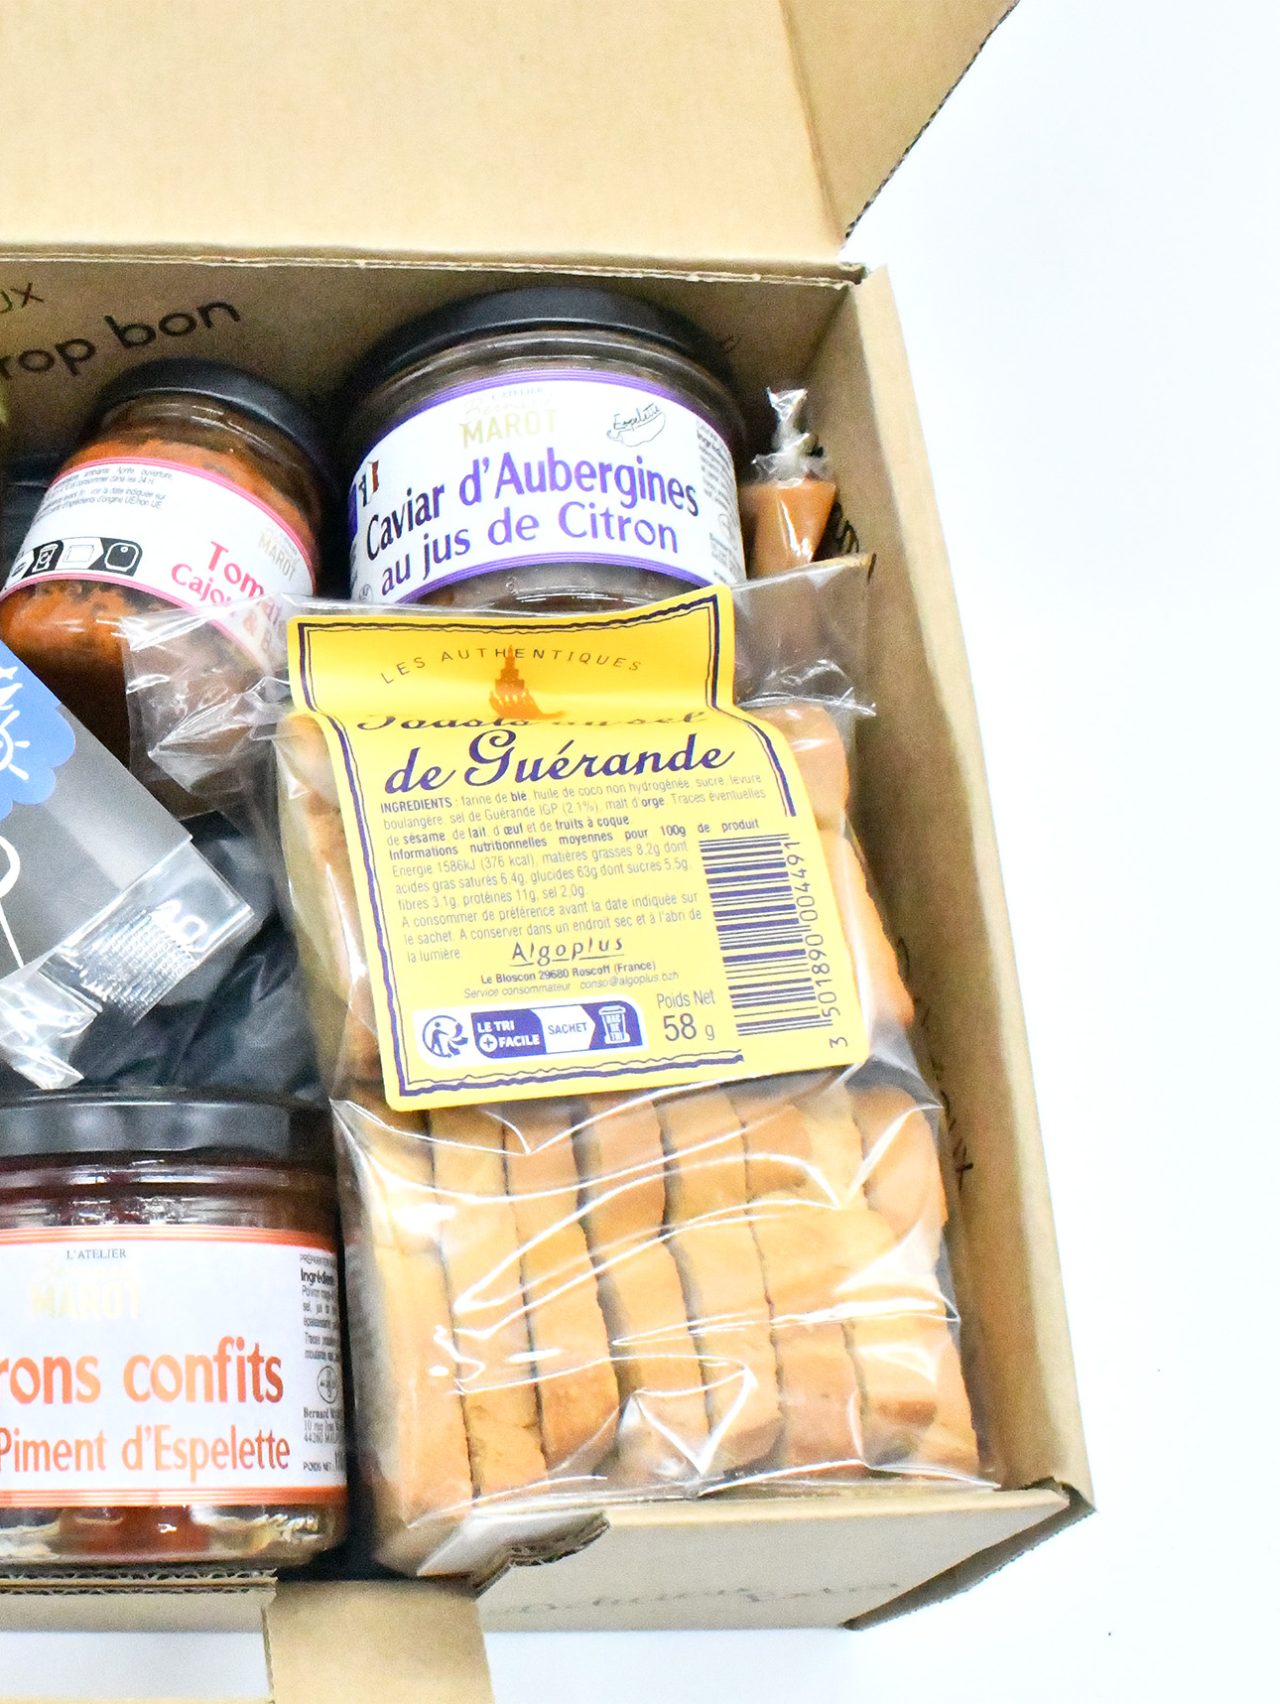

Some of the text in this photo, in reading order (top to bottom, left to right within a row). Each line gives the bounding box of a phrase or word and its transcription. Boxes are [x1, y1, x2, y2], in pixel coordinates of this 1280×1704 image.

[104, 300, 241, 349] bon
[365, 481, 446, 562] Caviar
[458, 446, 701, 517] d'Aubergines
[380, 501, 679, 597] au jus de Citron
[170, 562, 232, 608] Cajo
[380, 647, 643, 685] LES AUTHENTIQUES
[384, 728, 736, 795] de Guérande
[380, 797, 453, 814] INGREDIENTS
[460, 794, 492, 807] farine
[494, 792, 508, 804] de
[533, 788, 559, 800] huile
[562, 786, 575, 798] de
[578, 785, 604, 797] coco
[606, 783, 627, 794] non
[728, 774, 762, 785] levure
[450, 812, 465, 825] sel
[468, 810, 481, 823] de
[484, 805, 537, 822] Guérande
[540, 802, 558, 816] IGP
[606, 798, 628, 810] malt
[669, 792, 707, 805] Traces
[387, 835, 400, 847] de
[452, 829, 466, 841] de
[526, 822, 537, 833] et
[540, 820, 553, 833] de
[555, 817, 584, 831] fruits
[587, 818, 594, 829] à
[389, 818, 760, 862] Informations nutritionnelles moyennes pour 100g de produit
[392, 863, 433, 879] Energie
[438, 858, 476, 873] 1586kJ
[480, 855, 505, 872] (376
[542, 850, 588, 865] matières
[590, 846, 633, 862] grasses
[664, 841, 689, 853] dont
[395, 881, 430, 895] acides
[432, 879, 456, 894] gras
[458, 874, 498, 889] saturés
[531, 869, 575, 886] glucides
[577, 864, 598, 880] 63g
[600, 862, 625, 876] dont
[626, 859, 662, 874] sucres
[398, 898, 430, 911] fibres
[462, 891, 513, 907] protéines
[542, 885, 558, 899] sel
[413, 912, 478, 928] consommer
[482, 909, 496, 922] de
[499, 904, 556, 922] préférence
[559, 900, 589, 916] avant
[591, 898, 601, 912] la
[605, 896, 629, 911] date
[632, 892, 678, 909] indiquée
[681, 891, 698, 904] sur
[405, 932, 415, 946] le
[470, 926, 523, 941] conserver
[527, 922, 553, 937] dans
[556, 921, 570, 934] un
[573, 917, 611, 931] endroit
[614, 915, 633, 929] sec
[635, 913, 646, 927] et
[649, 912, 656, 926] à
[659, 909, 686, 924] l'abri
[689, 908, 702, 921] de
[783, 841, 849, 1049] 3 501890 004491
[407, 951, 417, 964] la
[511, 937, 624, 967] Algoplus
[481, 960, 657, 985] Le Bloscon 29680 Roscoff (France)
[463, 987, 499, 999] Service
[501, 983, 572, 997] consommateur
[656, 989, 716, 1010] Poids Net
[476, 1019, 515, 1034] LE TRI
[498, 1033, 542, 1049] FACILE
[547, 1021, 589, 1036] SACHET
[662, 1012, 716, 1042] 58 g
[66, 1248, 127, 1260] L'ATELIER
[123, 1336, 284, 1404] confits
[122, 1424, 291, 1483] d'Espelette
